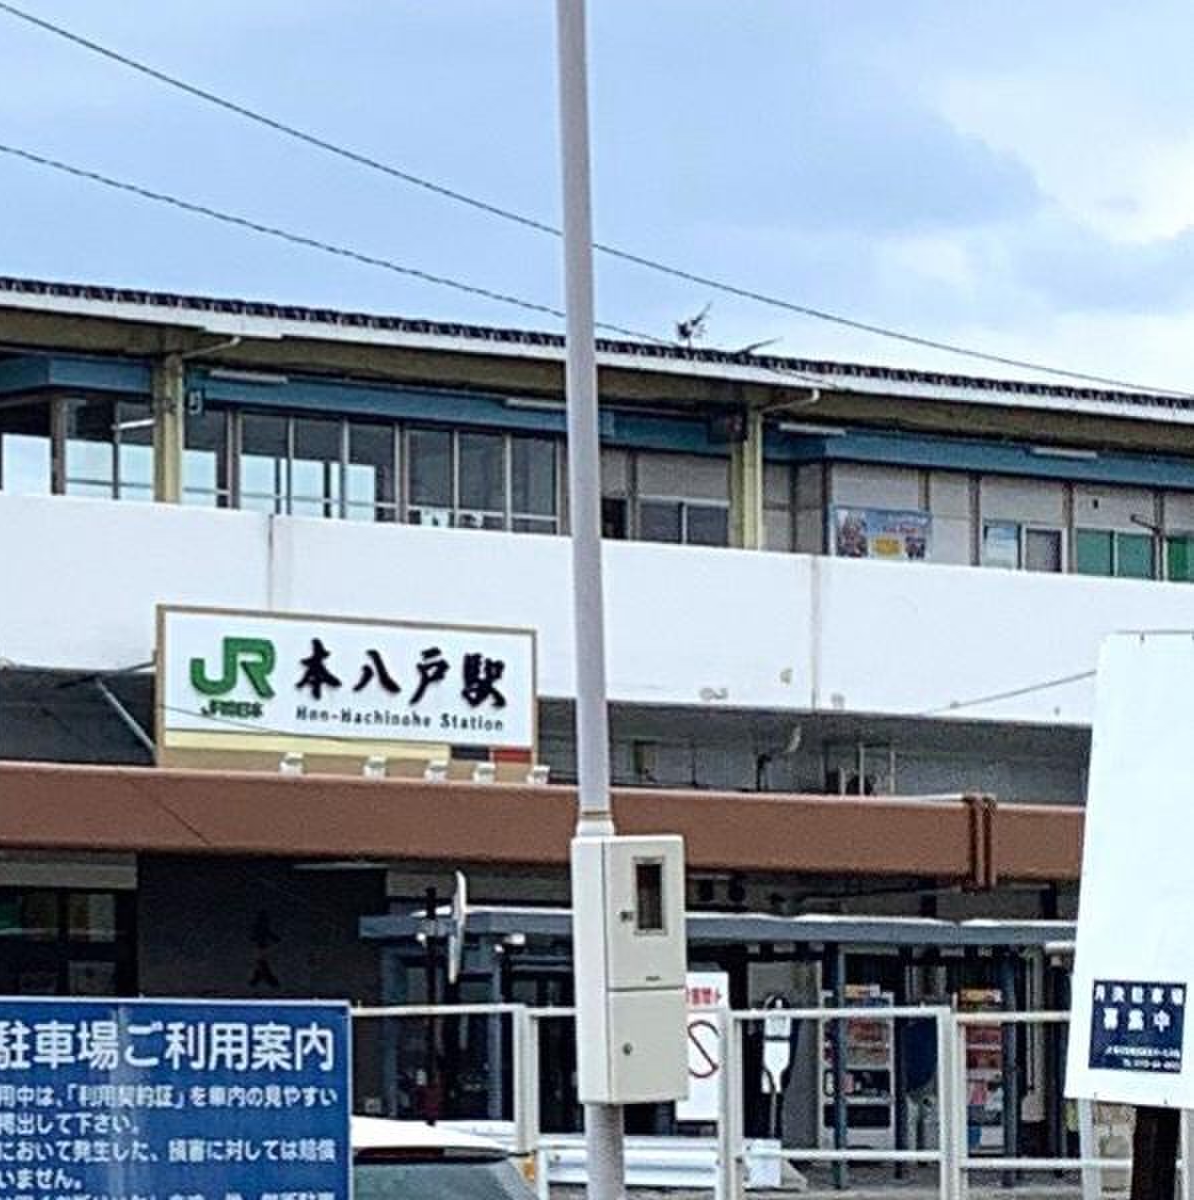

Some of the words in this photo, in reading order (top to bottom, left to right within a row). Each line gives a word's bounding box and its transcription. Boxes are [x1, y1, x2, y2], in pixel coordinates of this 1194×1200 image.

[189, 636, 276, 699] JR
[294, 638, 508, 709] 本八戸駅
[439, 712, 504, 731] Station
